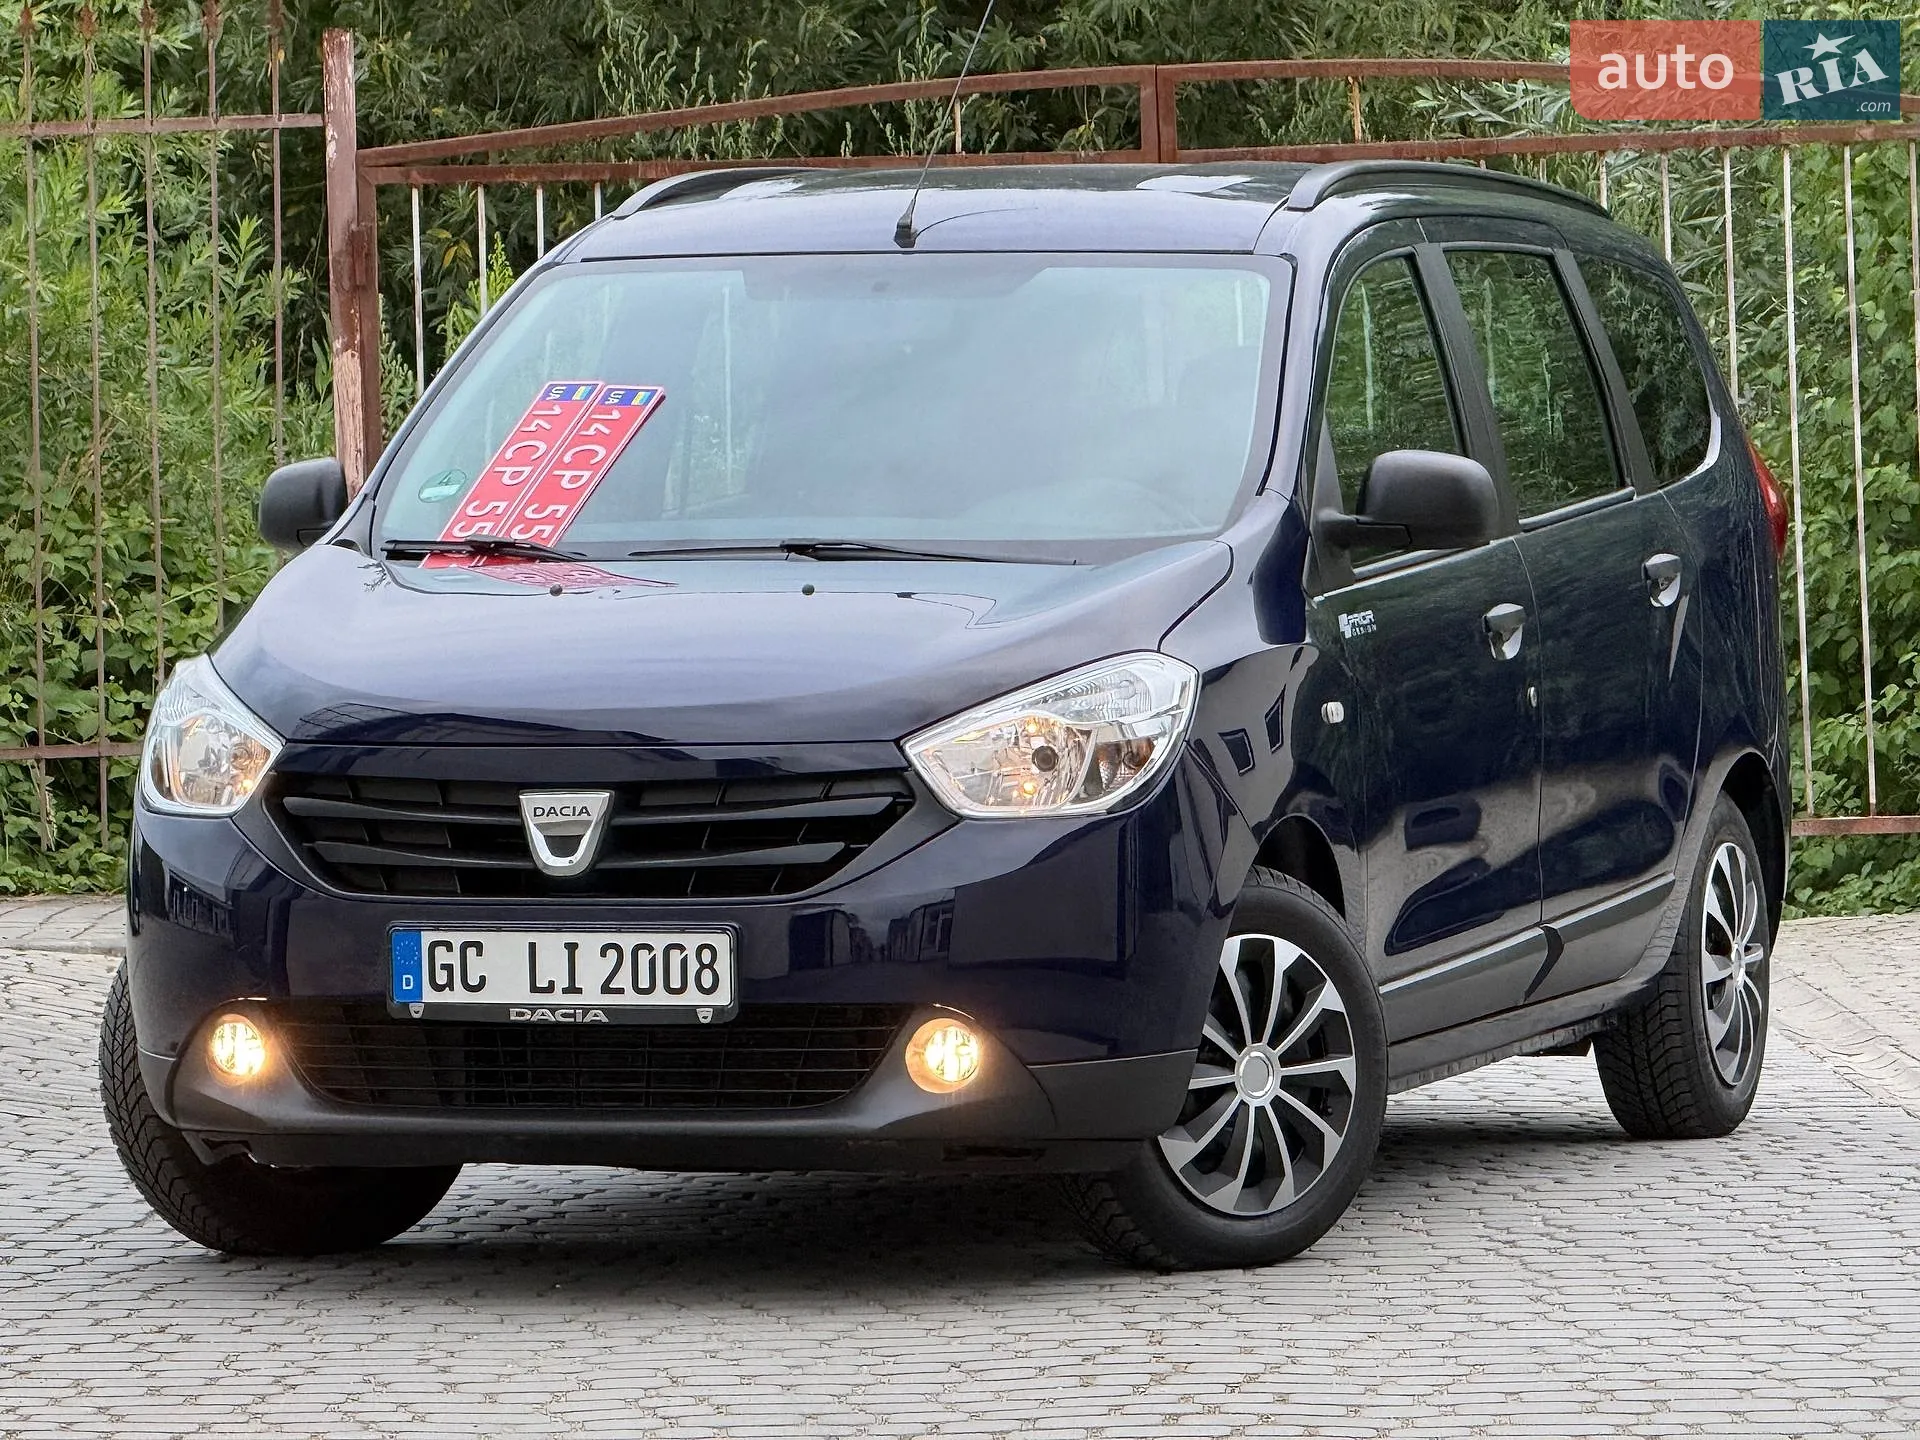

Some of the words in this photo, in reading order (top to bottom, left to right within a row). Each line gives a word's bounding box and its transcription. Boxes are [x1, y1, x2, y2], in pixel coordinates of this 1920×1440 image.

[546, 386, 566, 401] UA
[605, 390, 625, 405] UA
[533, 805, 591, 817] DACIA
[427, 940, 487, 993] GC
[528, 941, 583, 995] LI
[600, 942, 720, 996] 2008
[403, 975, 413, 989] D
[509, 1008, 609, 1023] DACIA
